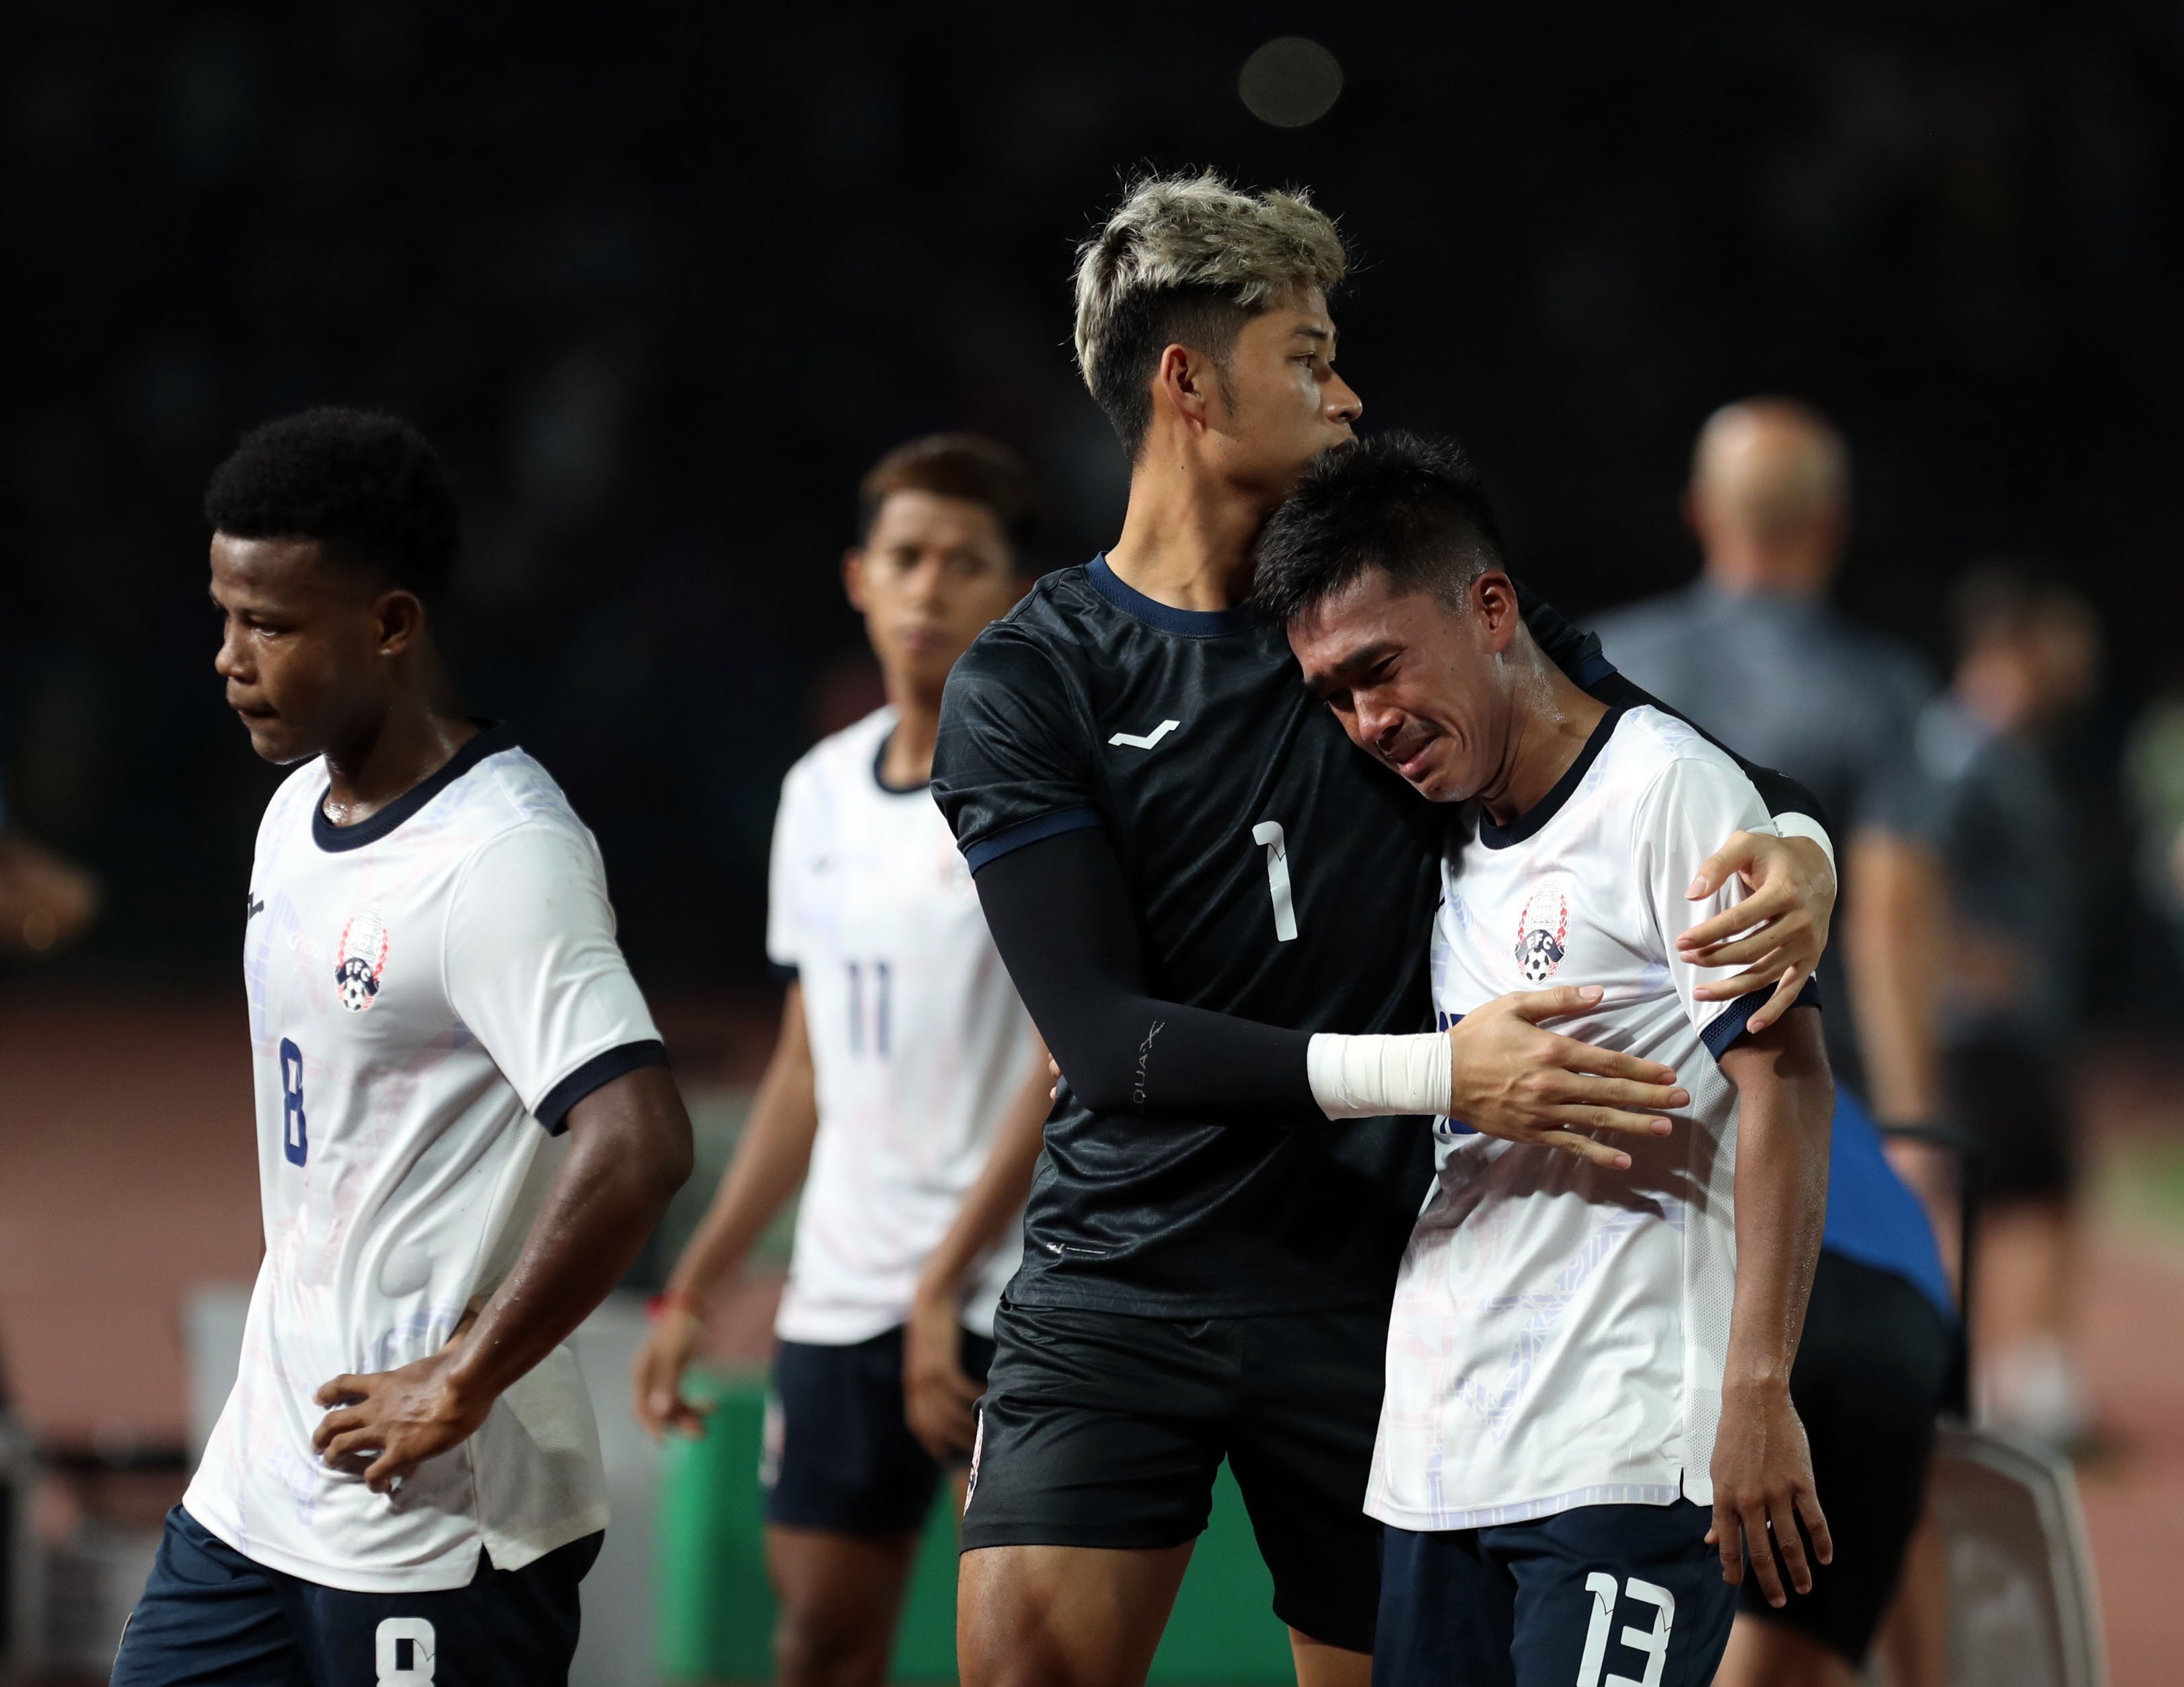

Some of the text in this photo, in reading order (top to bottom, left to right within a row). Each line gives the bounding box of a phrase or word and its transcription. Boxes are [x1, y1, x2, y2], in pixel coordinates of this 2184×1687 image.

[1252, 820, 1298, 942] 1
[345, 962, 371, 982] FFC
[1526, 933, 1553, 950] FFC
[845, 958, 891, 1062] 11
[280, 1037, 307, 1168] 8
[1576, 1572, 1675, 1687] 13
